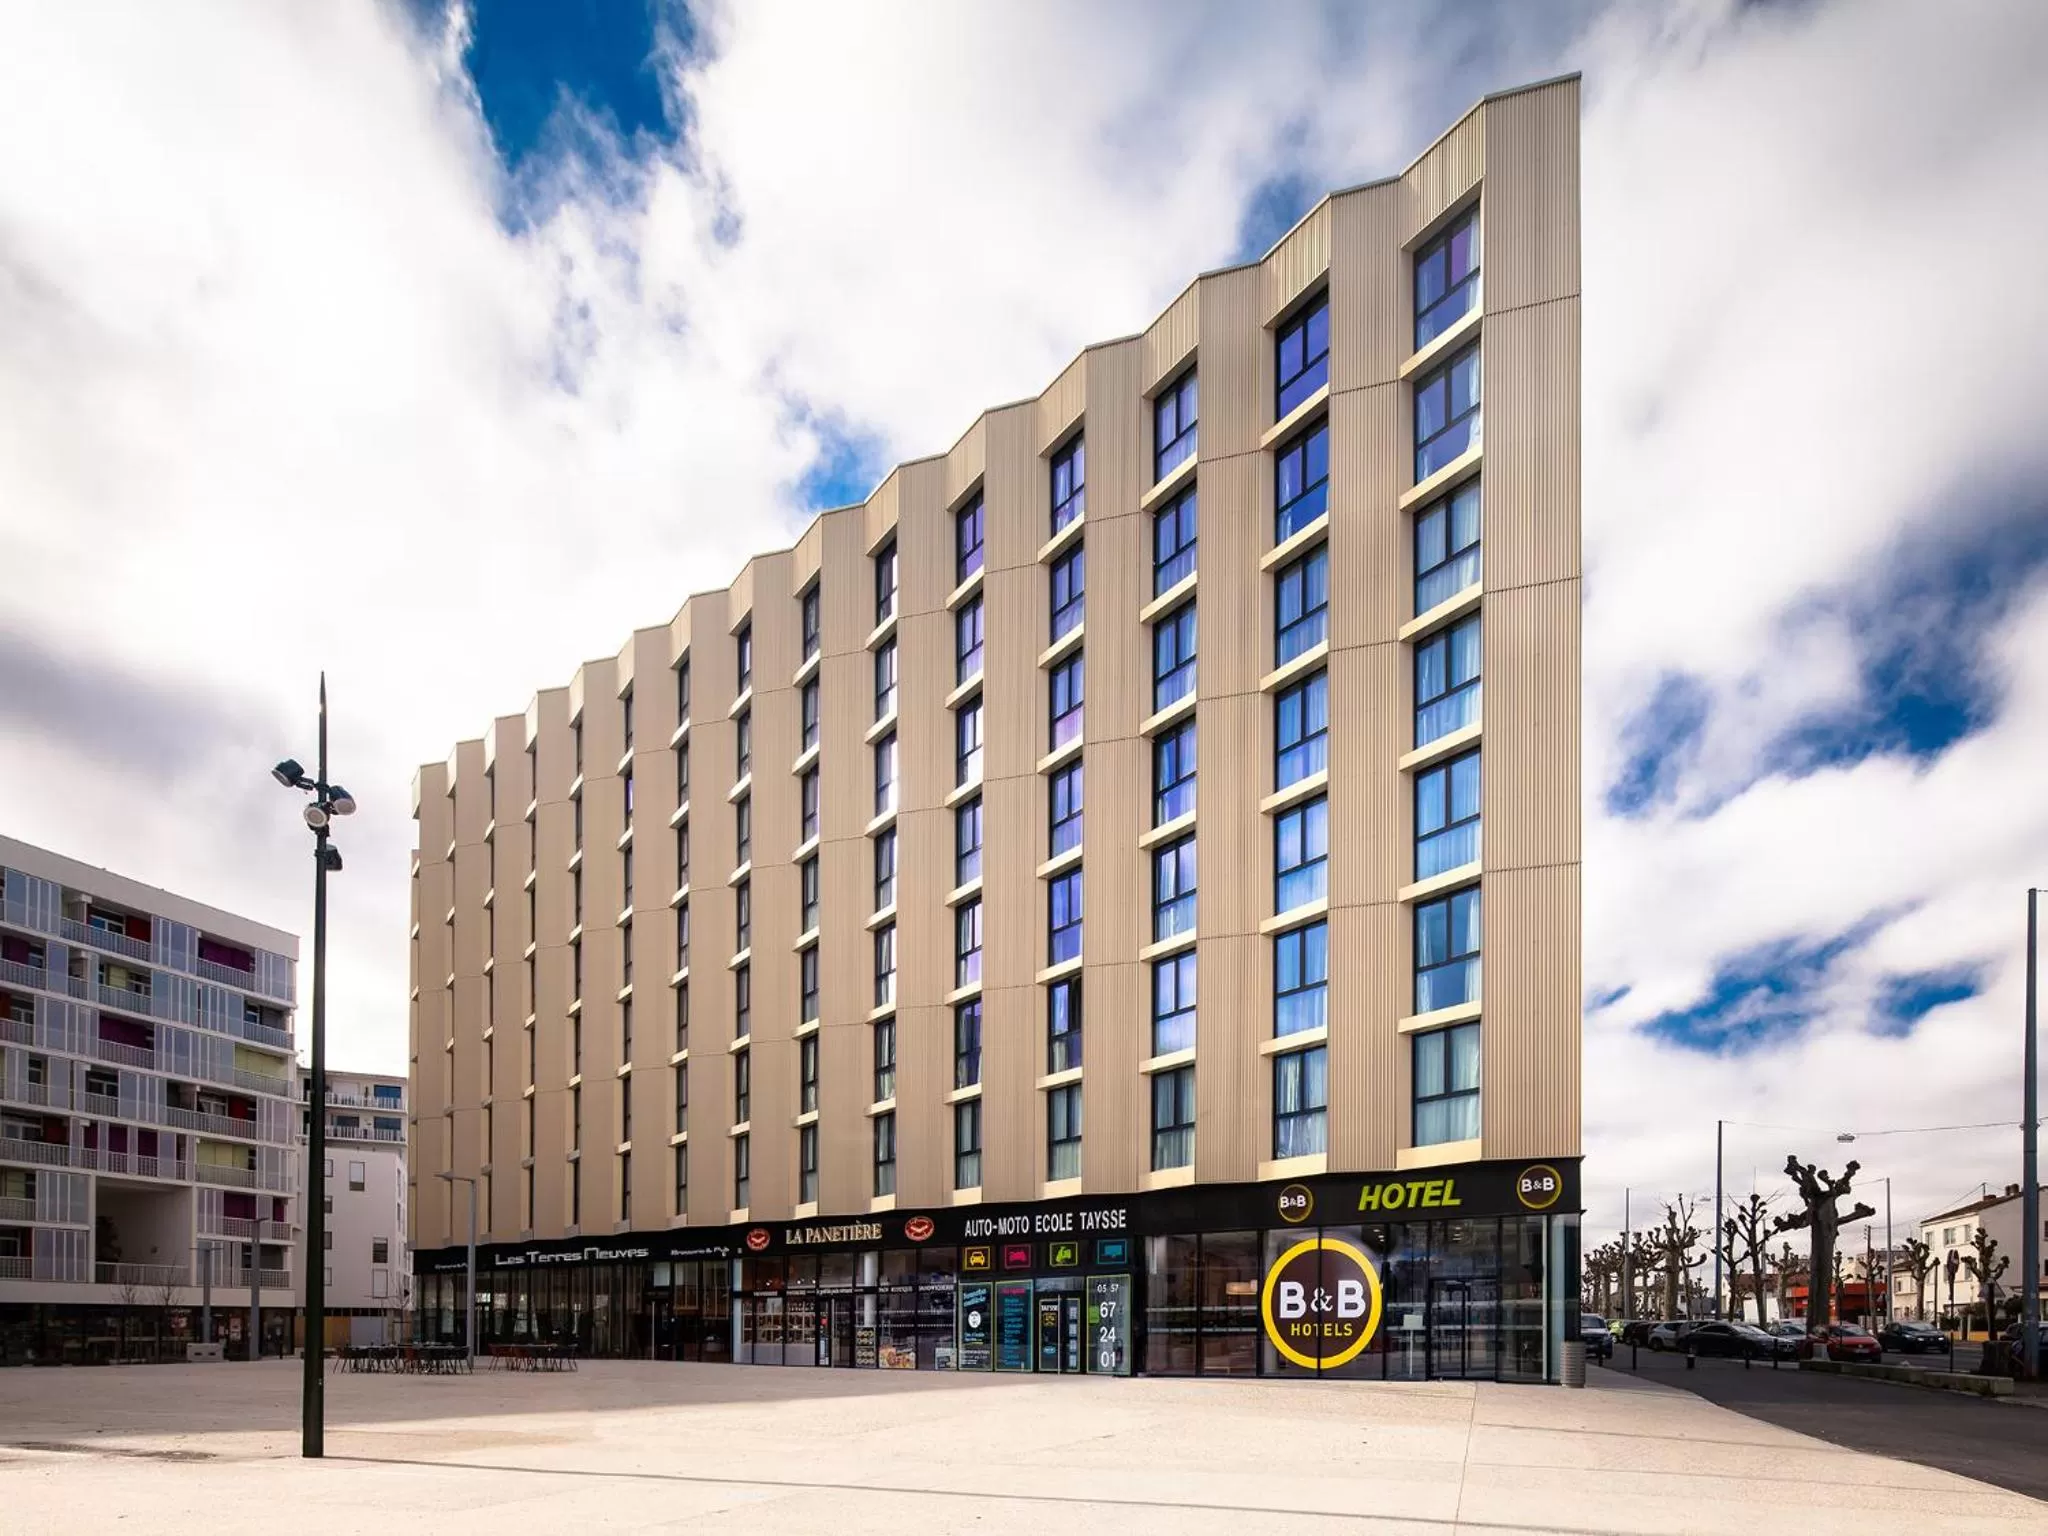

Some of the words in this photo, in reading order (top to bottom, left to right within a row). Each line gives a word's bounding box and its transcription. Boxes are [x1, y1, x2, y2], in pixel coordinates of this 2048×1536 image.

[1521, 1177, 1555, 1192] B&B
[1280, 1195, 1306, 1208] B&B
[1358, 1179, 1463, 1211] HOTEL
[965, 1216, 1030, 1237] AUTO-MOTO
[1035, 1213, 1073, 1233] ECOLE
[1080, 1209, 1127, 1229] TAYSSE
[785, 1229, 803, 1244] LA
[805, 1220, 883, 1243] PANETIÈRE
[495, 1253, 524, 1265] Les
[526, 1250, 582, 1263] Terres
[584, 1247, 649, 1261] Neuves
[1097, 1284, 1107, 1293] 05
[1110, 1283, 1119, 1293] 57
[1099, 1301, 1117, 1318] 67
[1099, 1326, 1116, 1343] 24
[1290, 1323, 1353, 1337] HOTELS
[1100, 1351, 1116, 1368] 01
